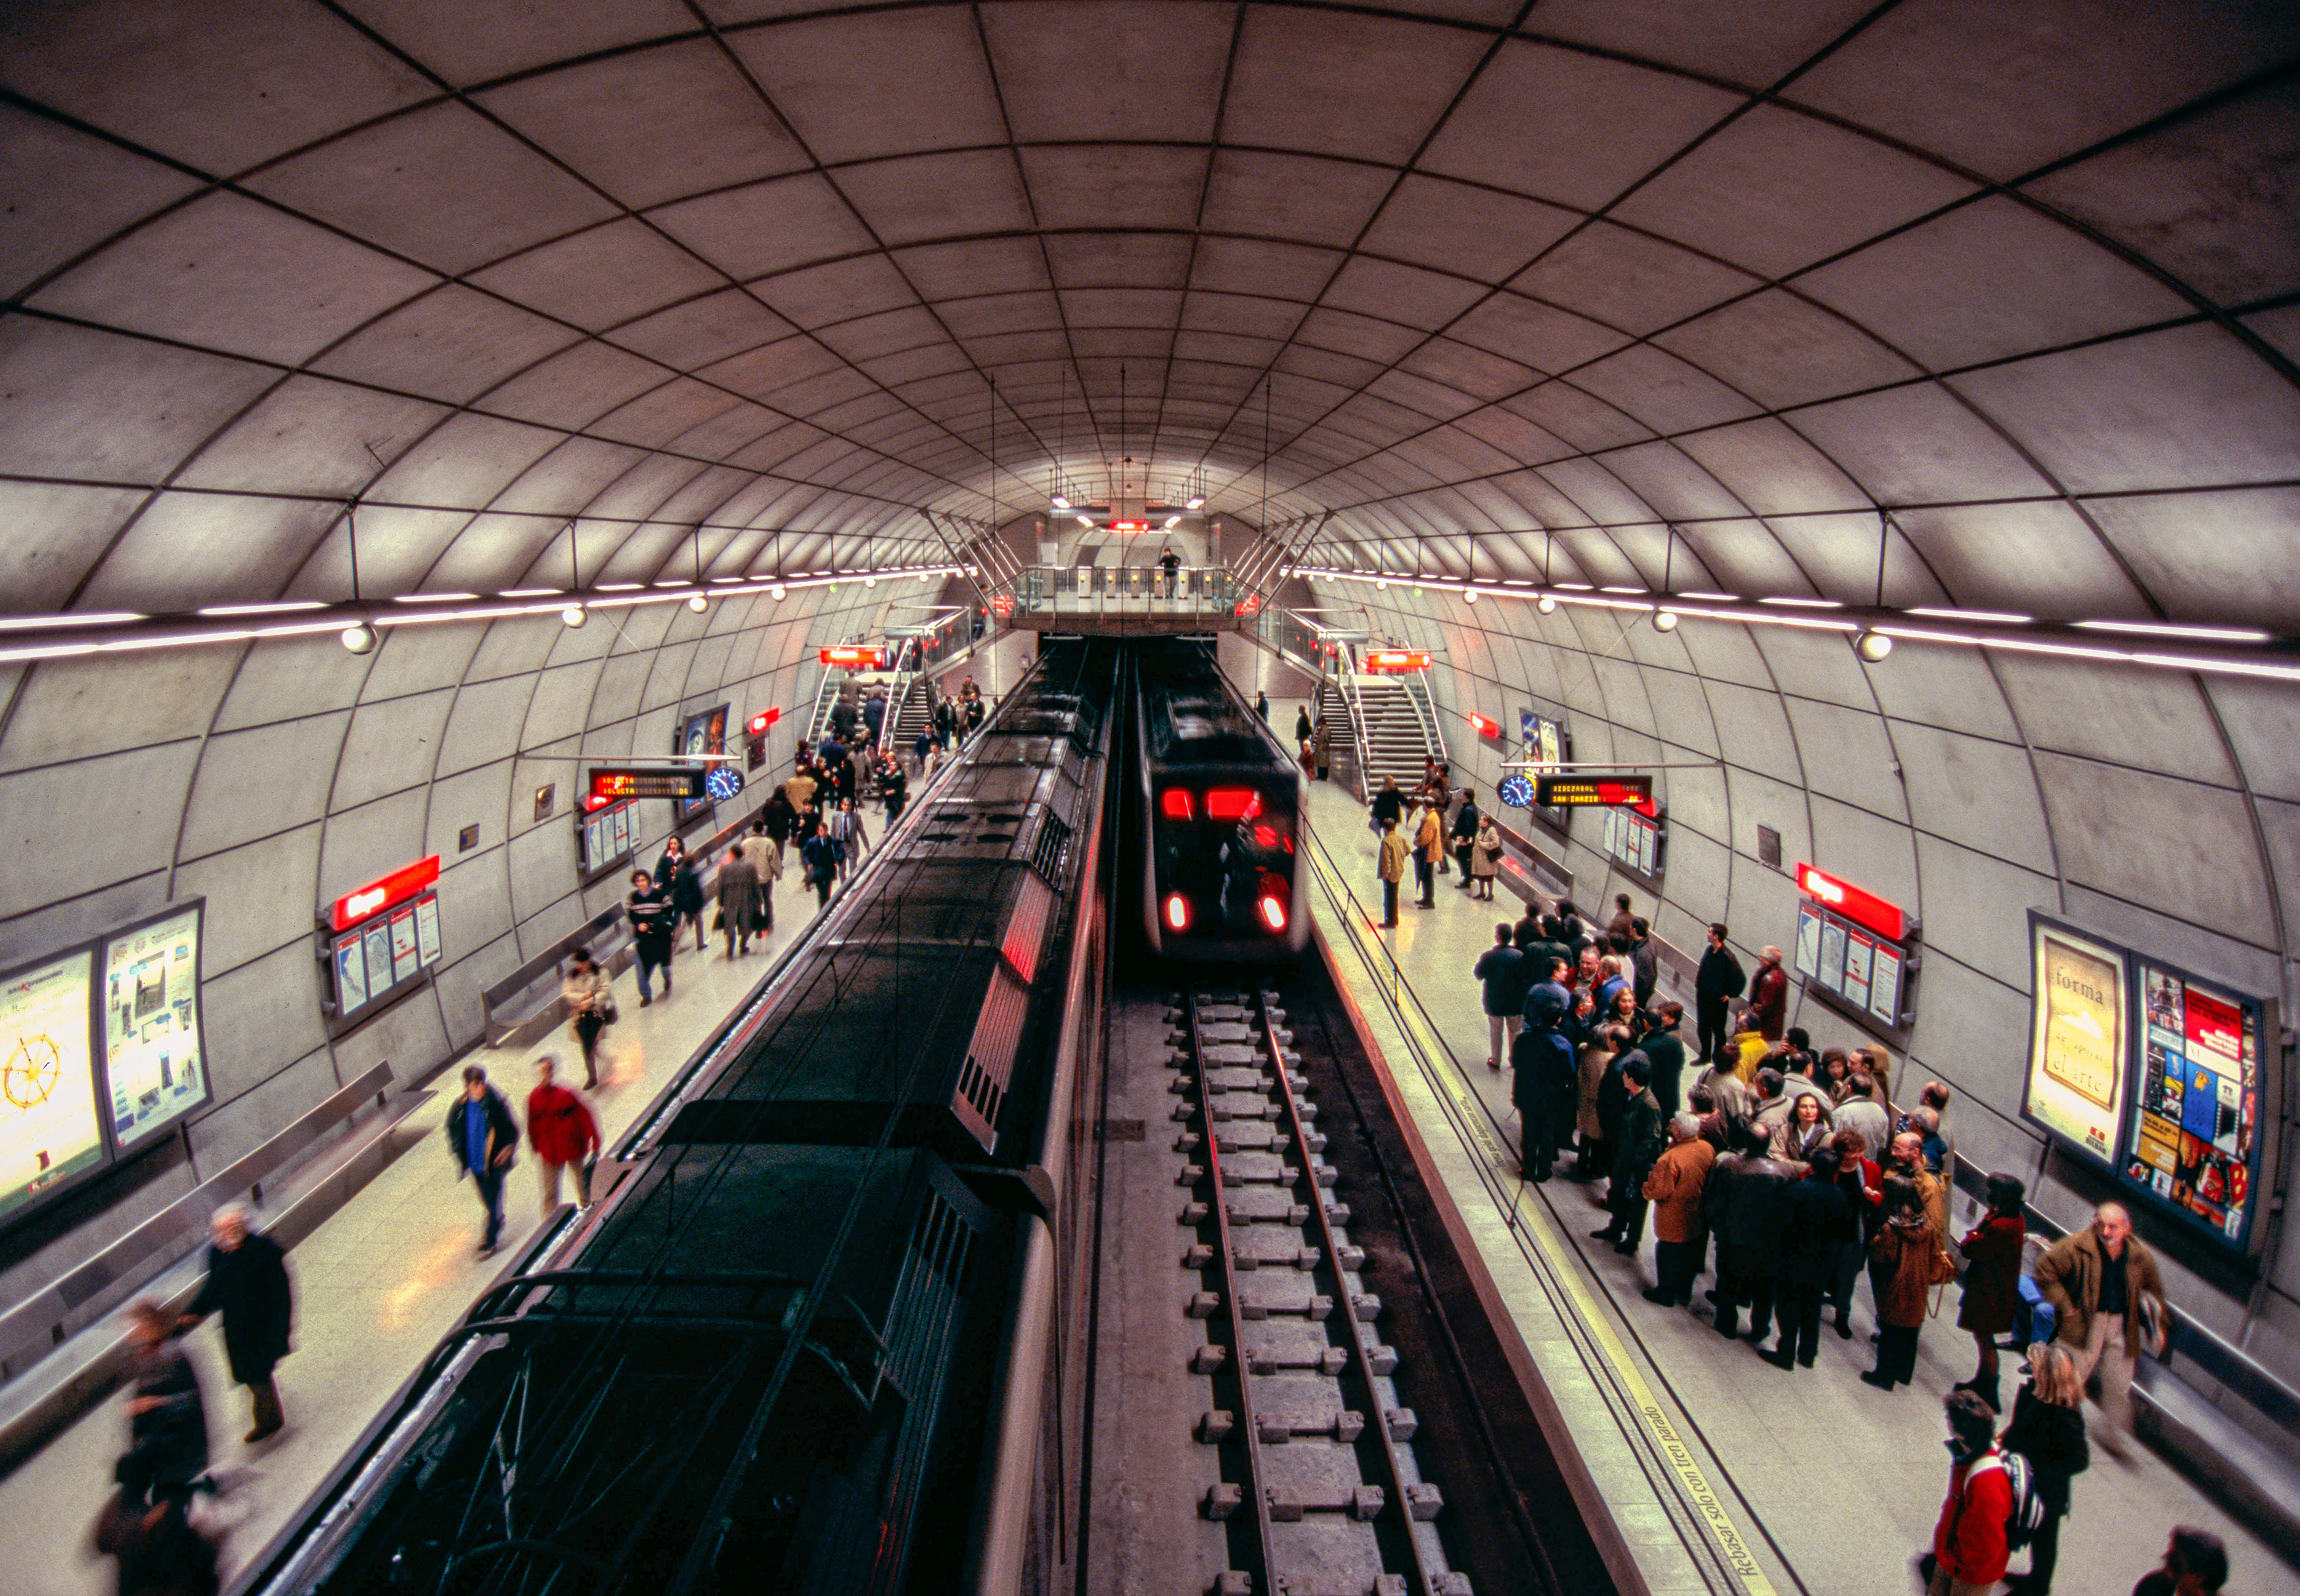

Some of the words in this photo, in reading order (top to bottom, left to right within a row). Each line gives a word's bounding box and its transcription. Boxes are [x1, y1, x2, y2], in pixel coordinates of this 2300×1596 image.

[2056, 966, 2104, 1005] forma
[2053, 1054, 2066, 1073] el
[1645, 1405, 1680, 1442] parado
[1668, 1444, 1691, 1468] tren
[1684, 1470, 1706, 1492] con
[1699, 1495, 1724, 1520] solo
[1716, 1524, 1759, 1577] Rebasar
